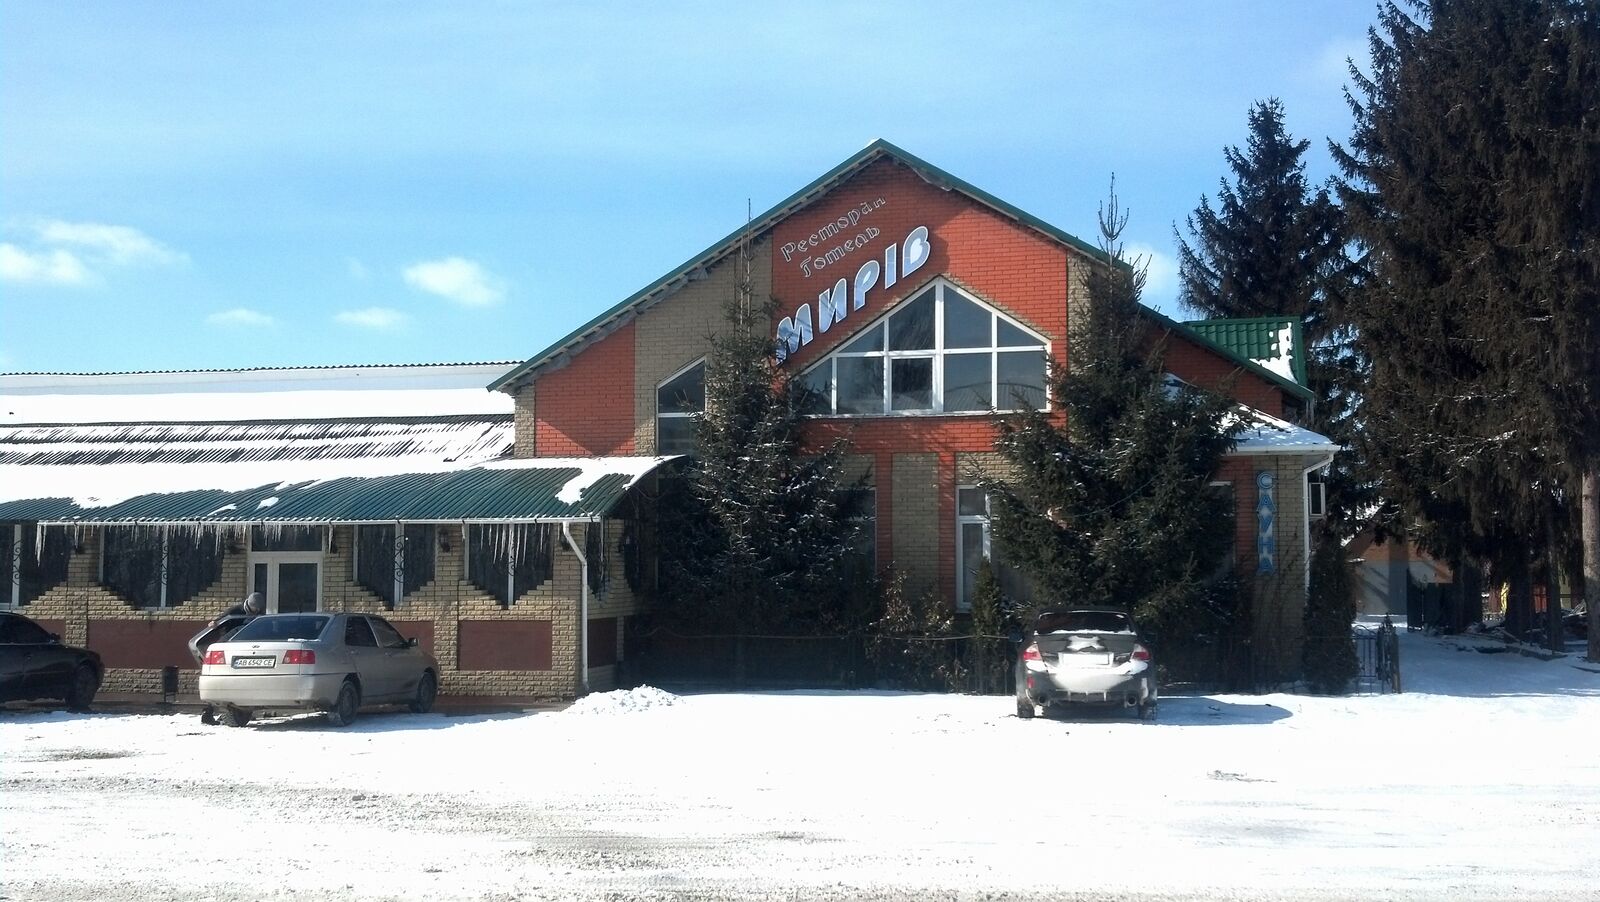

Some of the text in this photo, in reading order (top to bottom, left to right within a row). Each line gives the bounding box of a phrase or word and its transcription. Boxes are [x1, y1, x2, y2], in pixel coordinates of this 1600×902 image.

[780, 197, 886, 262] Ресторан
[800, 227, 880, 277] Готель
[775, 225, 931, 366] МИРІВ
[1256, 473, 1277, 576] САУНА
